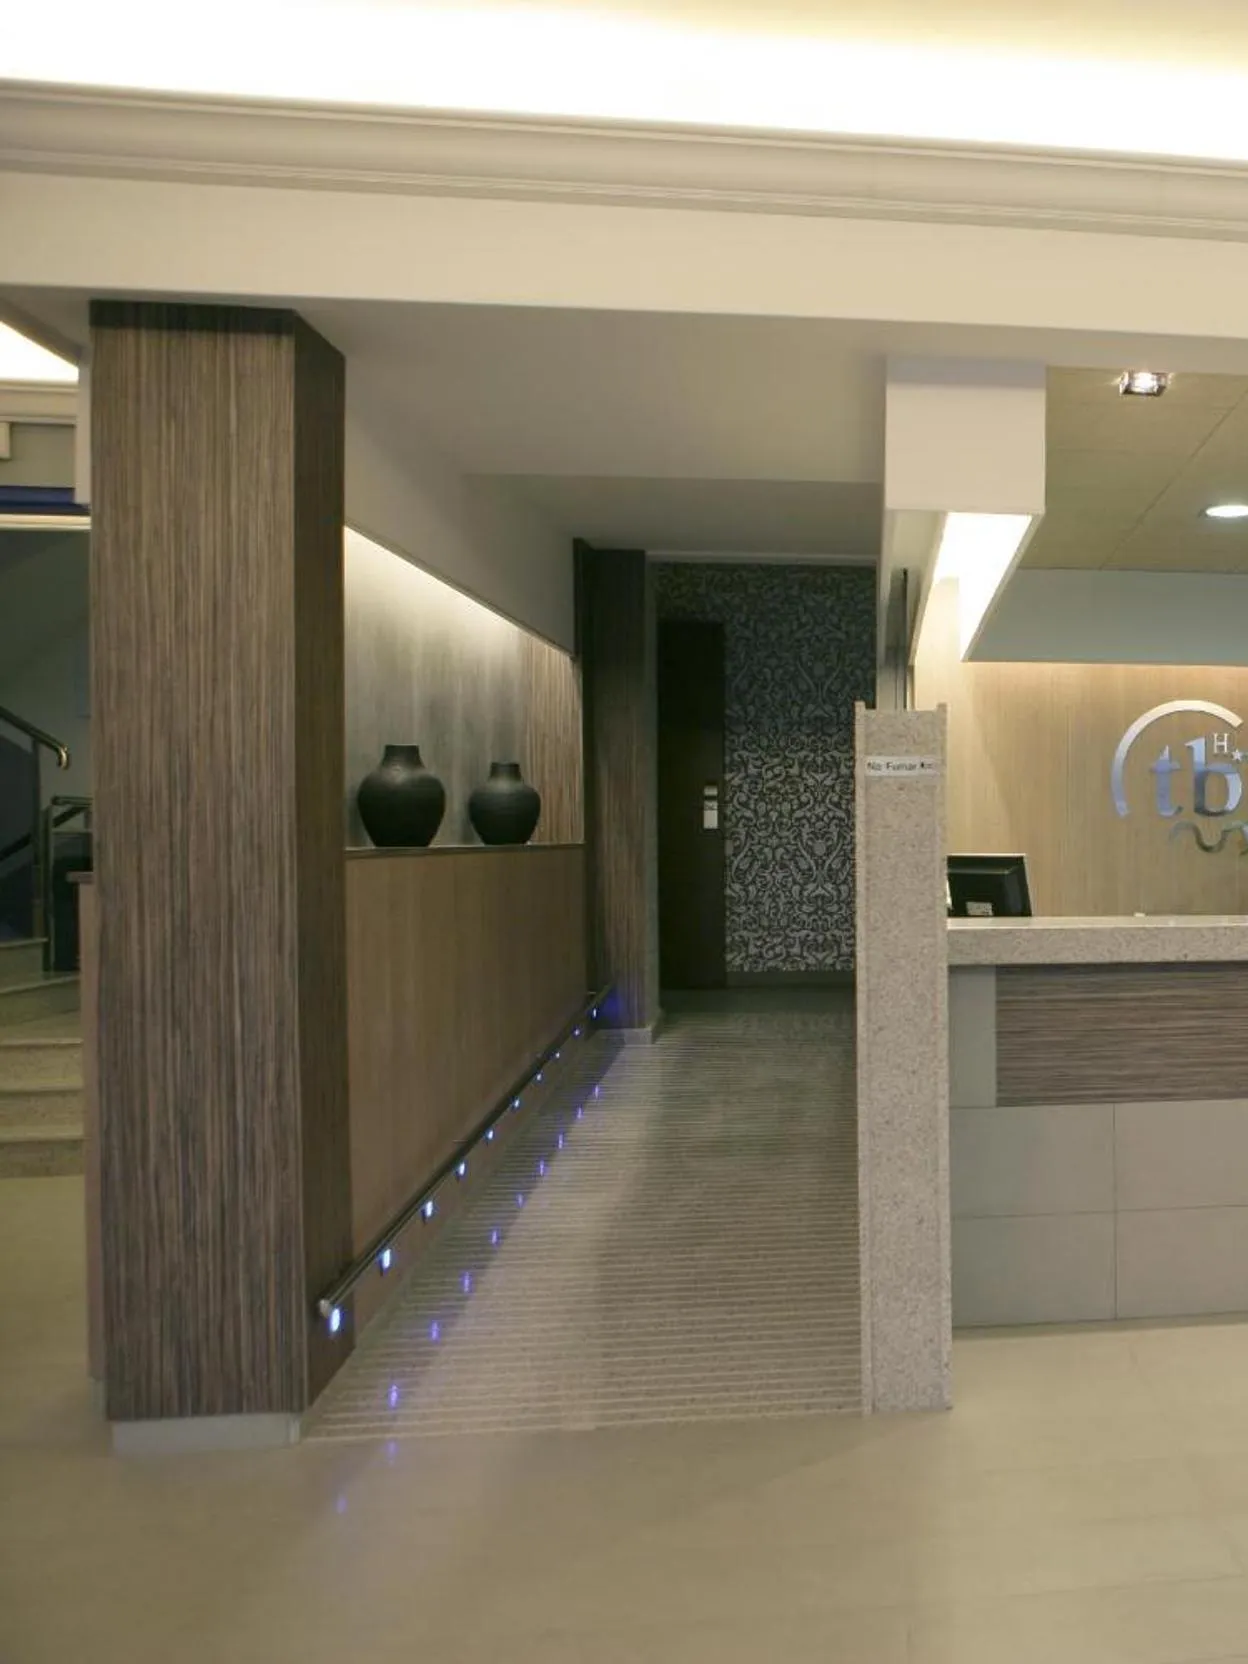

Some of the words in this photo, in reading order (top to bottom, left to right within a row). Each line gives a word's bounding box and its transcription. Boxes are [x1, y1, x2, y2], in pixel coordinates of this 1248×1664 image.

[1213, 733, 1228, 754] H
[867, 761, 882, 771] No
[1149, 737, 1242, 817] tb
